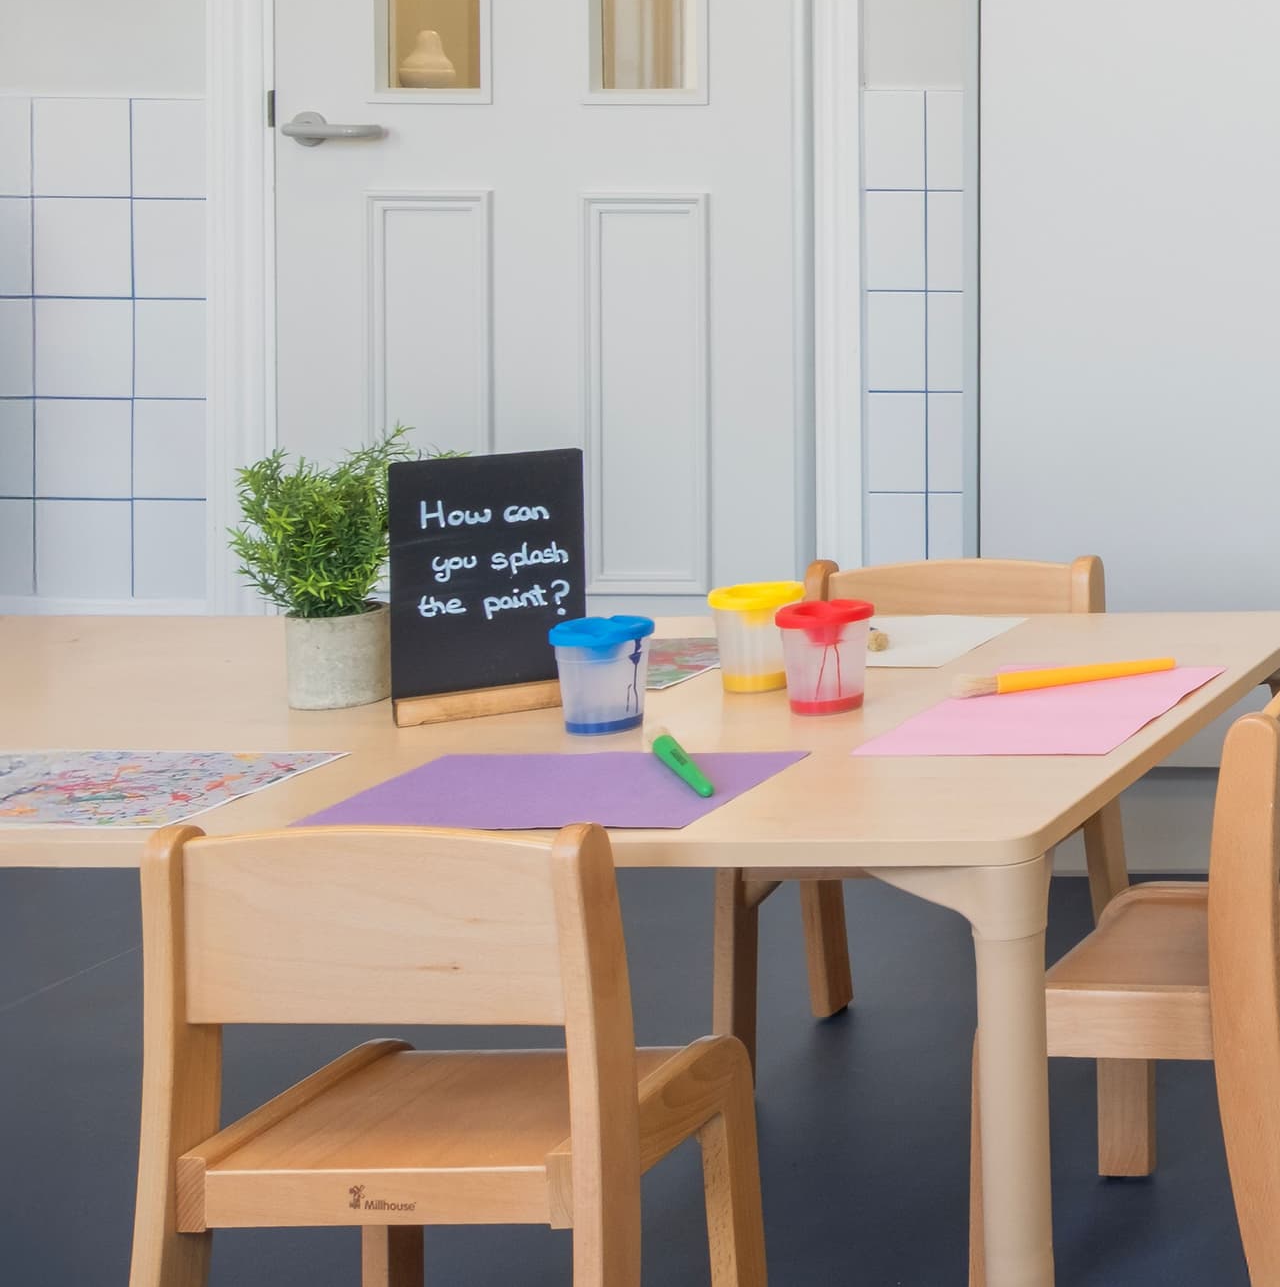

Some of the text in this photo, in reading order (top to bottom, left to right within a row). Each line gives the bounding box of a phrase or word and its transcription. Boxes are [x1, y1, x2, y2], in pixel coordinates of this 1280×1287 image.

[420, 499, 550, 530] How can
[431, 541, 569, 583] you splash
[417, 579, 570, 620] the paint?
[364, 1199, 417, 1211] Millhouse
